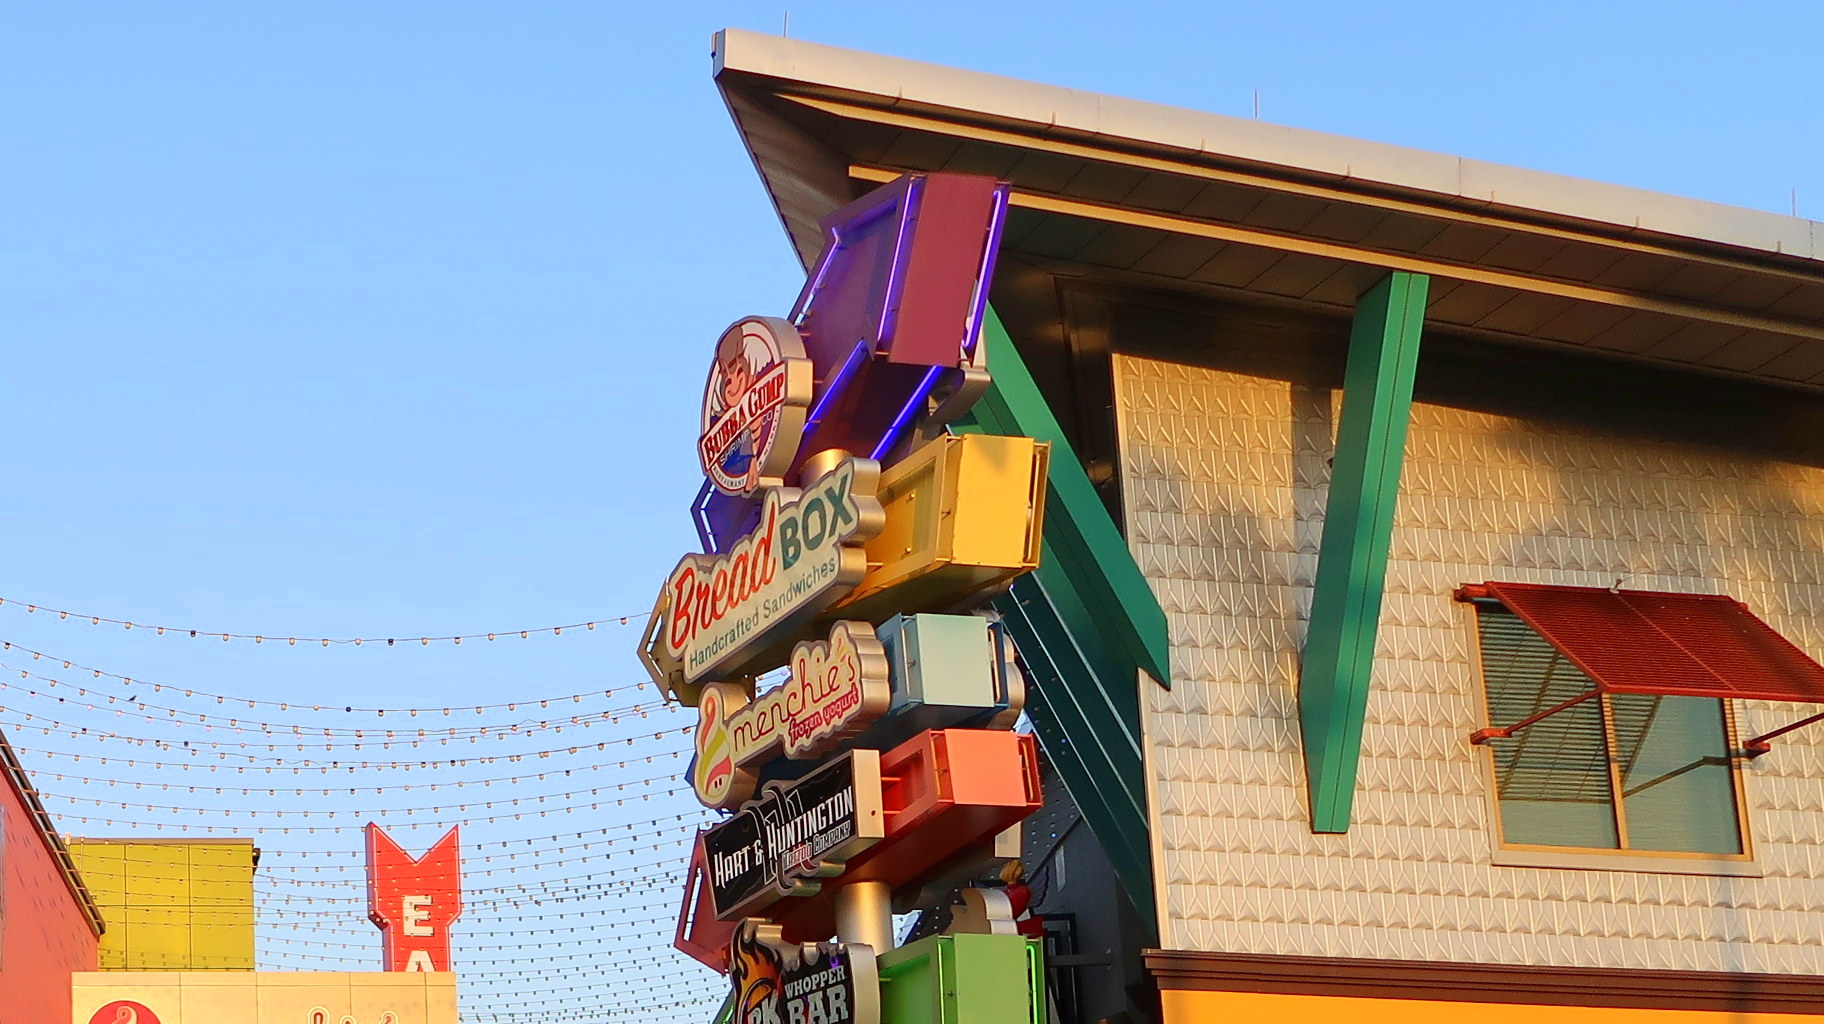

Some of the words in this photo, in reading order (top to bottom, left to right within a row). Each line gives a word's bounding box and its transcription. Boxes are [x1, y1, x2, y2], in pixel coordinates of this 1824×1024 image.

[704, 403, 747, 460] BUBBA
[748, 372, 785, 417] GUMP
[719, 428, 751, 468] SHRIMP
[713, 465, 746, 488] RESTAURANT
[671, 501, 776, 650] Bread
[779, 473, 854, 572] BOX
[689, 608, 760, 672] Handcrafted
[762, 556, 836, 620] Sandwiches
[733, 655, 856, 752] menchie's
[788, 711, 822, 748] frozen
[822, 682, 859, 727] yogurt
[713, 847, 750, 889] HART
[754, 840, 763, 867] &
[765, 785, 854, 862] HUNTINGTON
[813, 819, 851, 856] COMPANY
[784, 965, 846, 1000] WHOPPER
